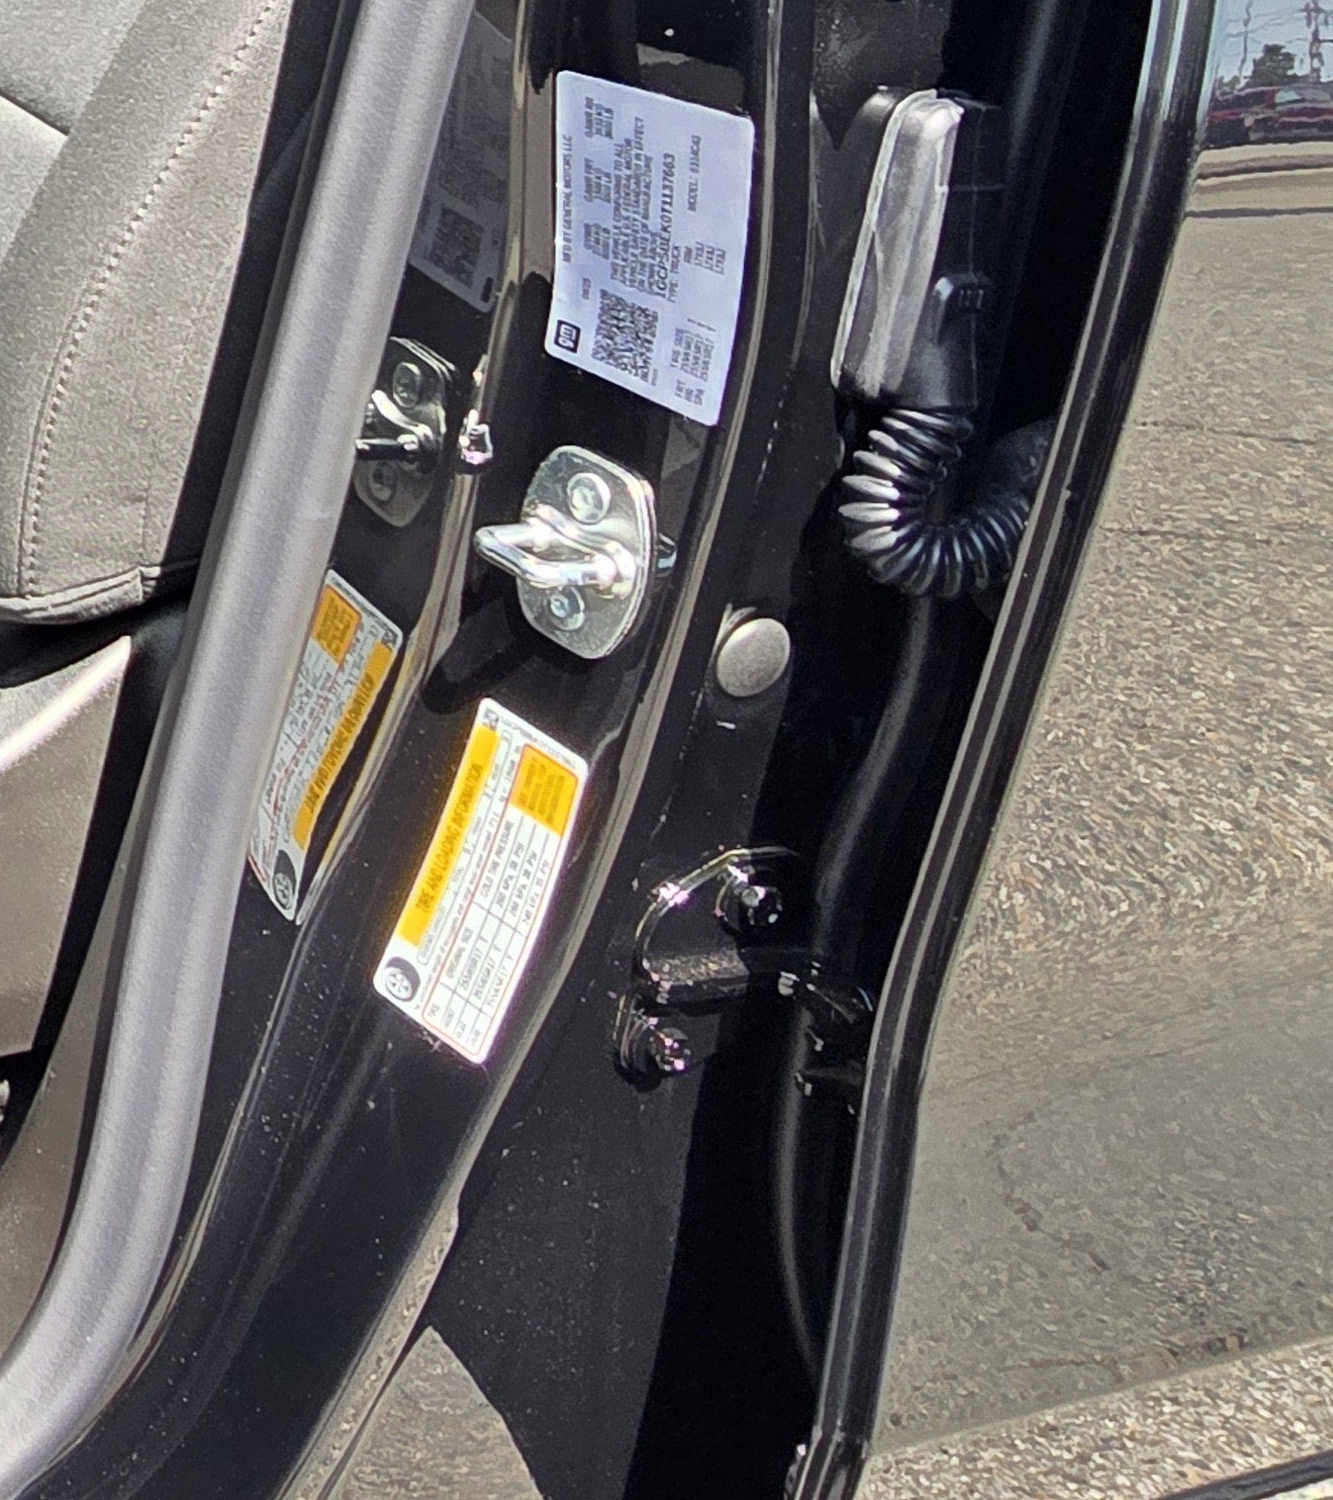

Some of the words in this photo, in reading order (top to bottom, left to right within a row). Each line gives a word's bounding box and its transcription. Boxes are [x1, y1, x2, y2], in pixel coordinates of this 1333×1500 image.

[563, 133, 572, 152] LLC
[633, 116, 643, 151] EFFECT
[614, 142, 622, 158] ALL
[623, 137, 632, 170] MOTOR
[563, 151, 571, 189] MOTORS
[614, 158, 622, 171] TO
[563, 189, 572, 230] GENERAL
[670, 243, 680, 274] TRUCK
[558, 322, 576, 350] gm
[451, 760, 483, 828] INFORMATION
[433, 824, 460, 871] LOADING
[479, 874, 493, 898] COLD
[494, 819, 514, 859] PRESSURE
[513, 841, 524, 858] PSI
[526, 849, 538, 867] PSI
[425, 866, 444, 892] AND
[539, 858, 550, 875] PSI
[416, 888, 435, 915] TIRE
